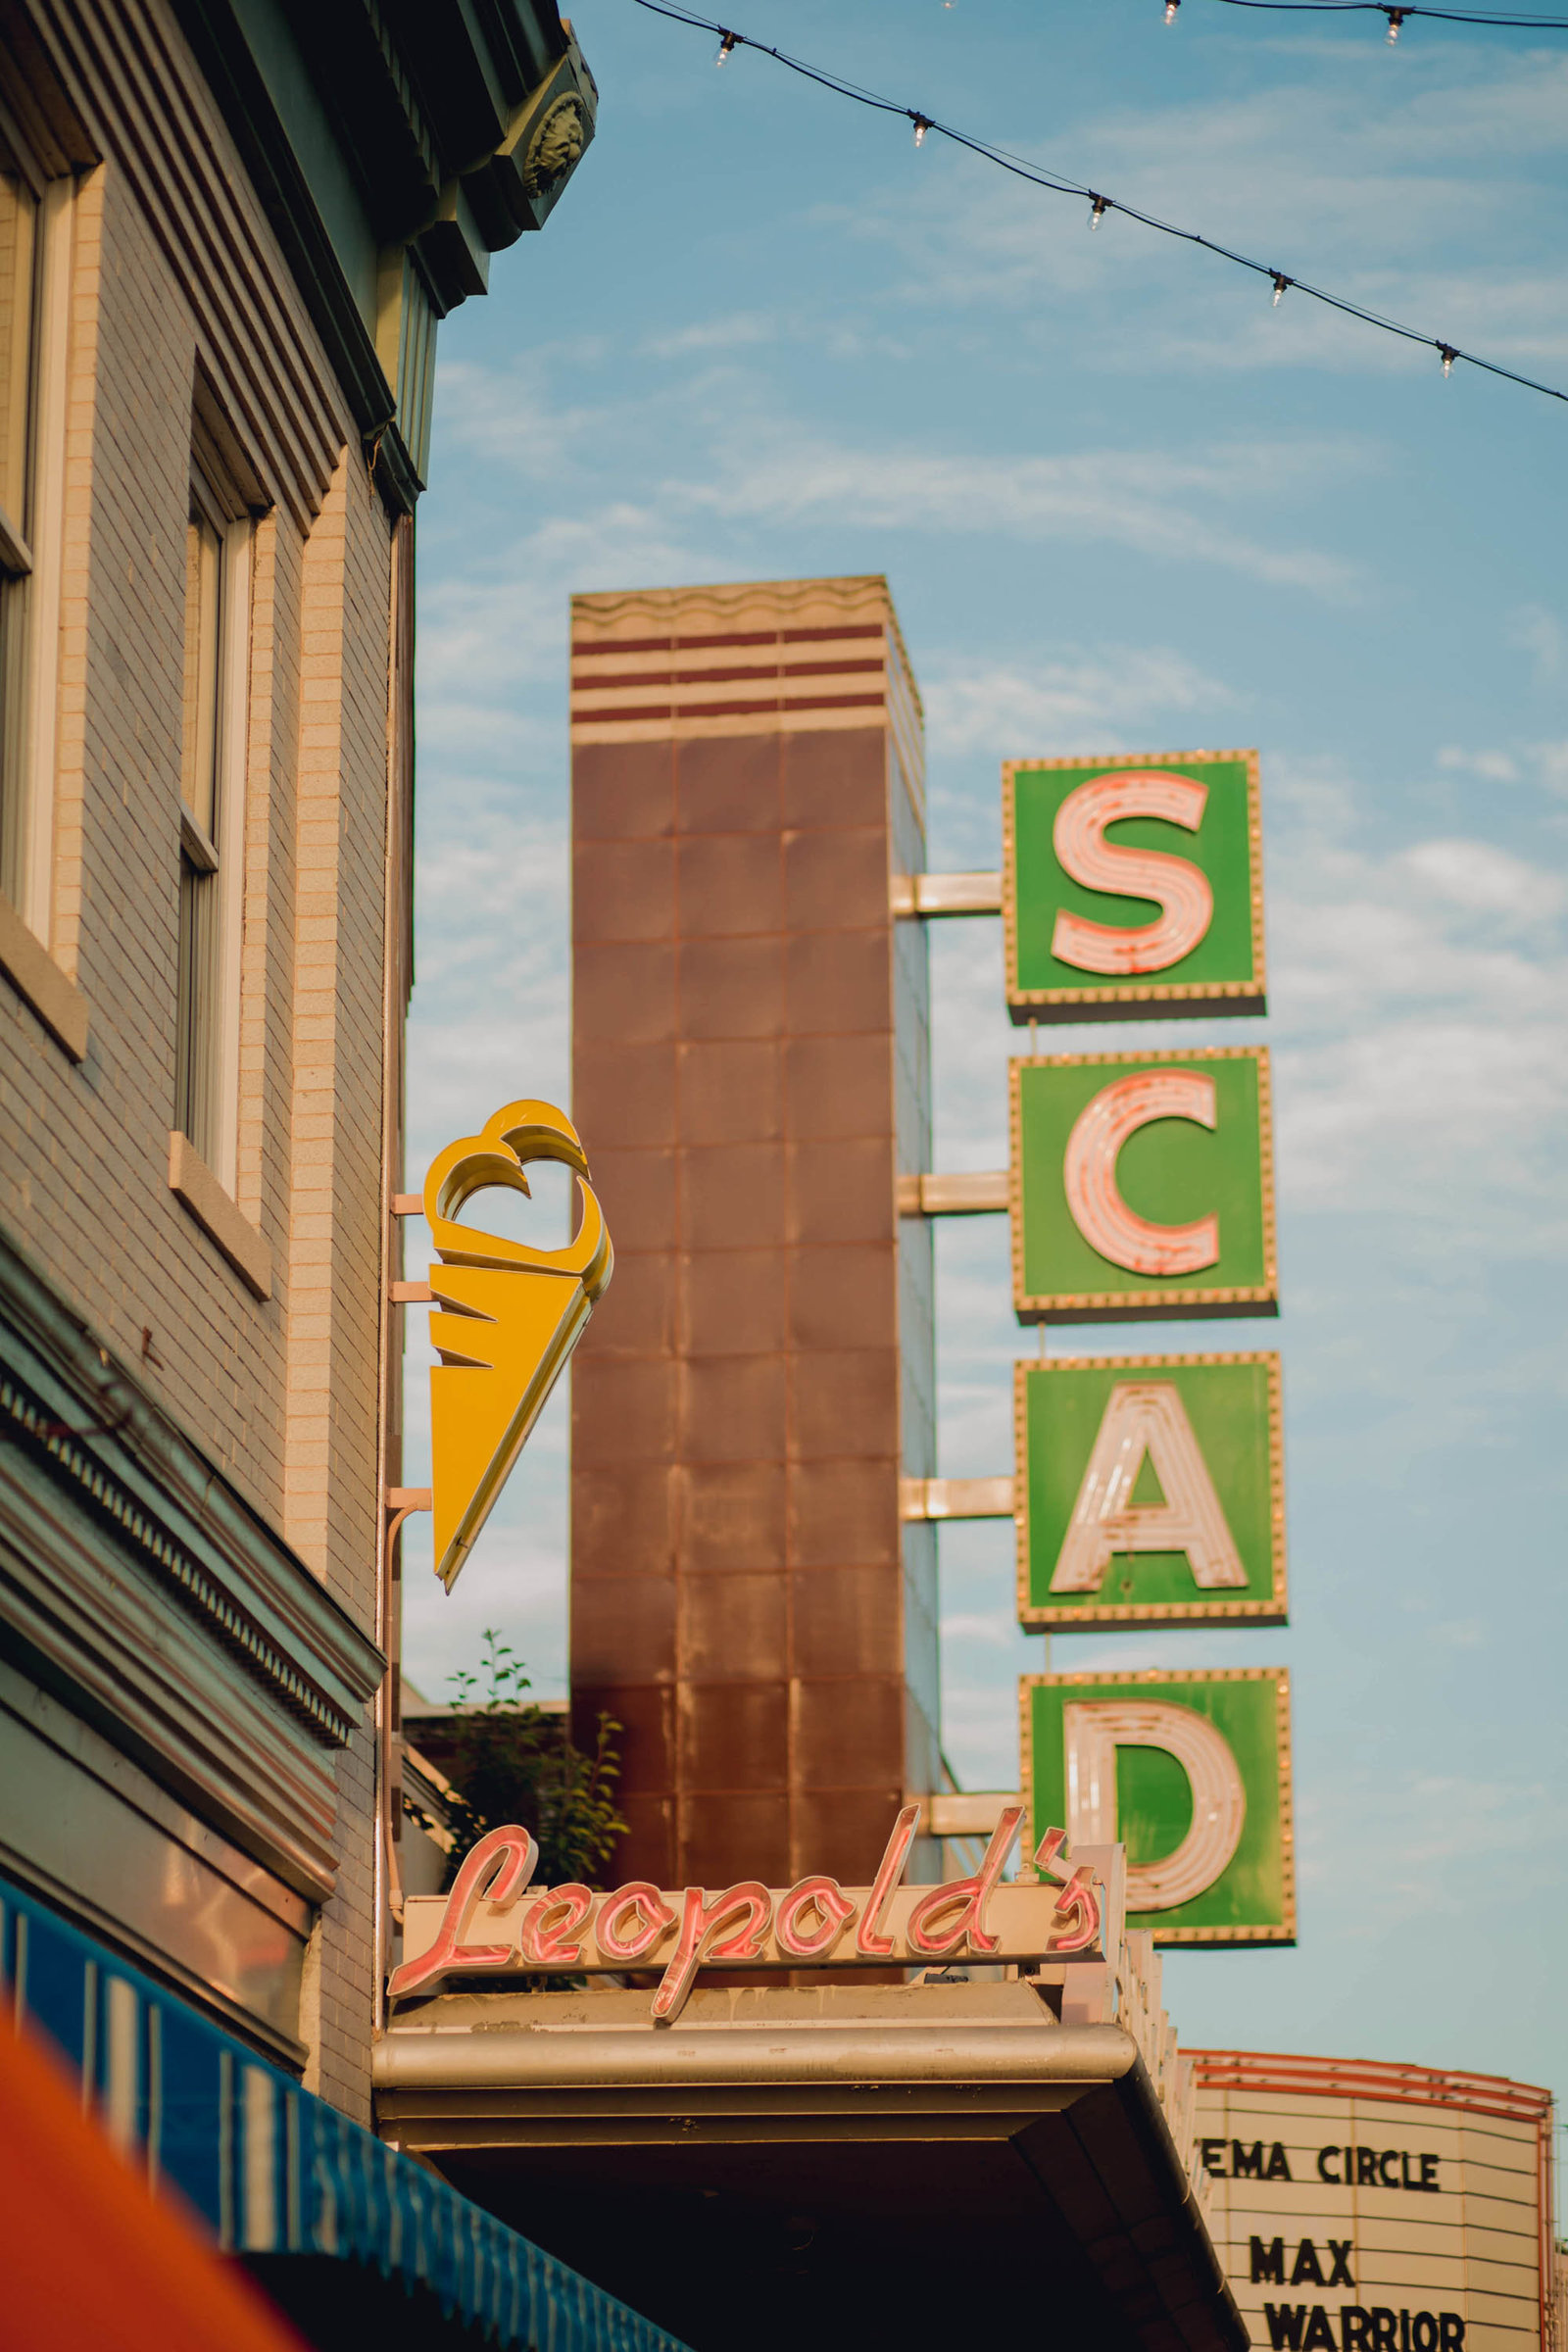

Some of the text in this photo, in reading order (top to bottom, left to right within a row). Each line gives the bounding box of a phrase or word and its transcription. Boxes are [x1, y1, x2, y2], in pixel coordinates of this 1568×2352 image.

[1052, 769, 1247, 1913] SCAD
[387, 1803, 1102, 2019] Leopold's
[1194, 2138, 1440, 2191] EMA CIRCLE
[1250, 2235, 1355, 2286] MAX
[1264, 2303, 1465, 2352] WARRIOR
